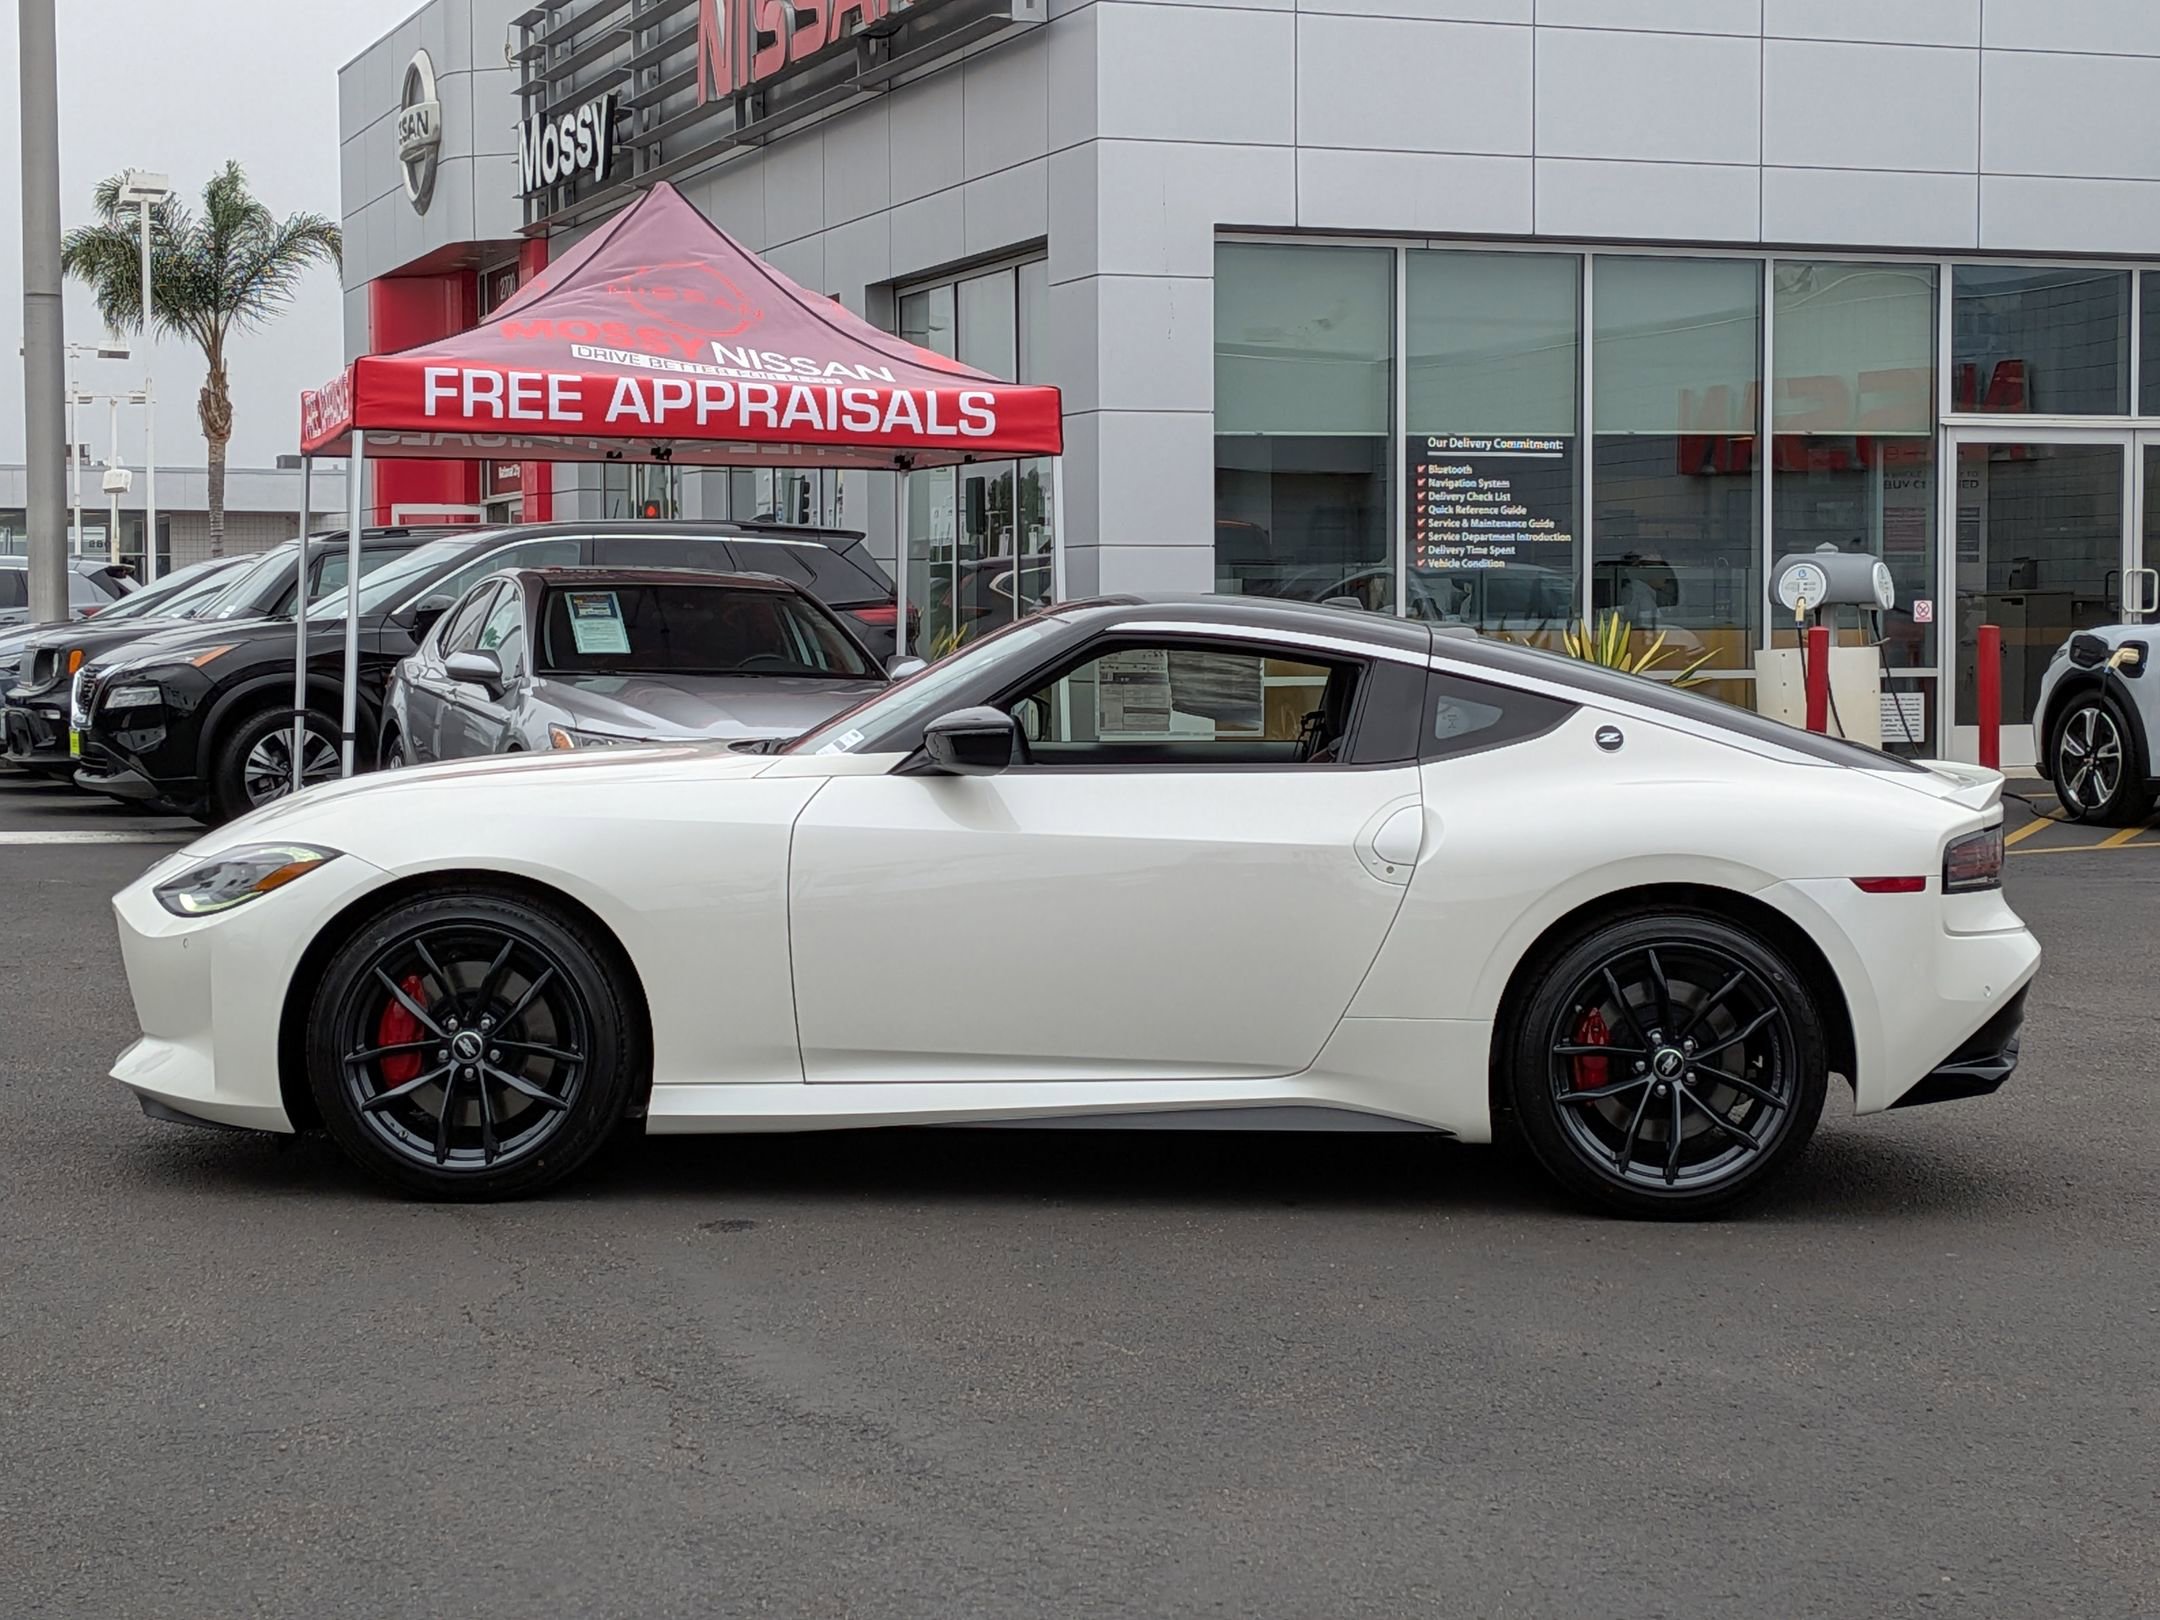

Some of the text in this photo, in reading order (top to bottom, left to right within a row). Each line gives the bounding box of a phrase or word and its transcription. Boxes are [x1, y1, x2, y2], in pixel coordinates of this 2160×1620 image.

[518, 94, 609, 197] Mossy
[502, 318, 706, 361] MOSSY
[711, 341, 896, 383] NISSAN
[577, 346, 641, 366] DRIVE
[424, 366, 996, 437] FREE APPRAISALS
[1427, 437, 1564, 451] Our Delivery Commitment:
[1428, 465, 1473, 475] Bluetooth
[1428, 478, 1510, 490] Navigation System
[1428, 491, 1511, 502] Delivery Check List
[1428, 505, 1527, 515] Quick Reference Guide
[1428, 519, 1555, 528] Service & Maintenance Guide
[1428, 532, 1571, 543] Service Department Introduction
[1428, 545, 1516, 556] Delivery Time Spent
[1428, 559, 1505, 568] Vehicle Condition
